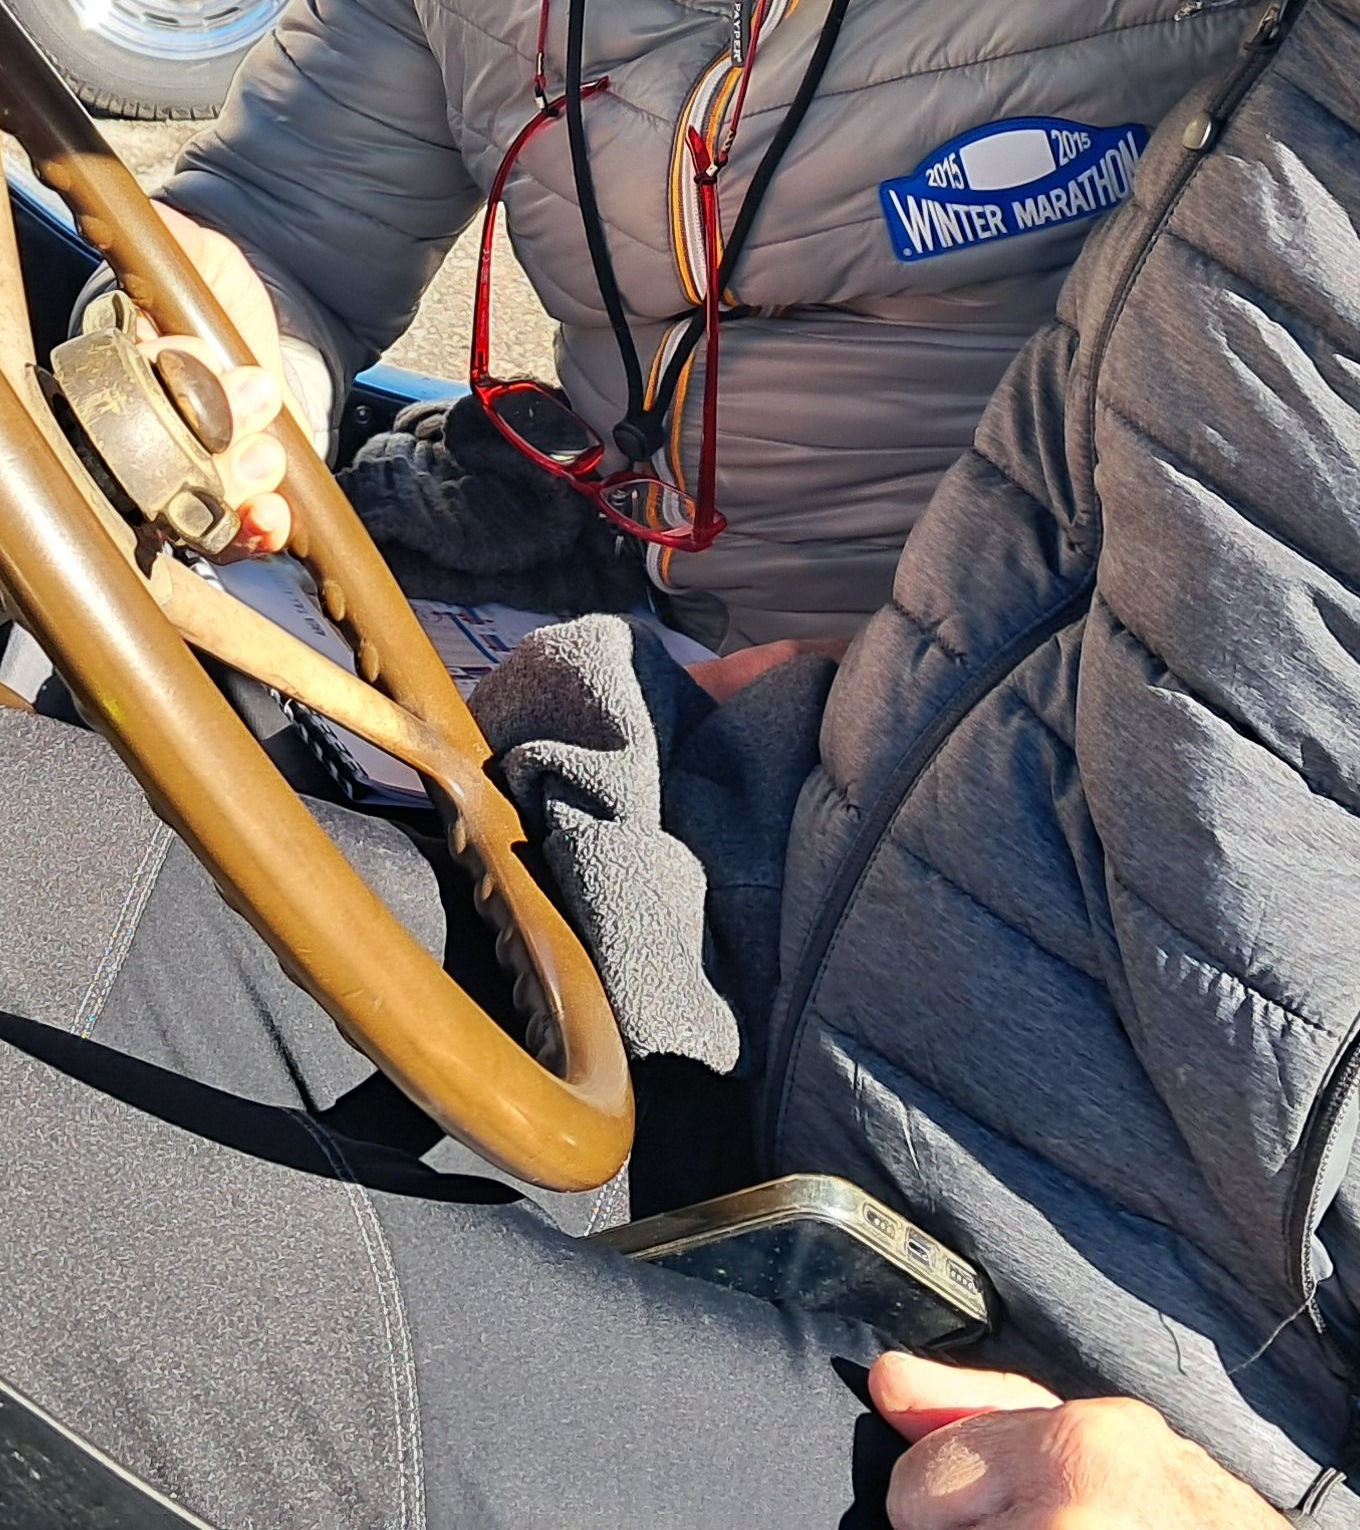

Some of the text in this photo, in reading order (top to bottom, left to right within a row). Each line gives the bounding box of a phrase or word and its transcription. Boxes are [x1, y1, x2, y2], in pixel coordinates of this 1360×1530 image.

[732, 2, 743, 62] PAYPER
[925, 128, 1091, 190] 2015 2015
[889, 130, 1140, 254] WINTER MARATHON
